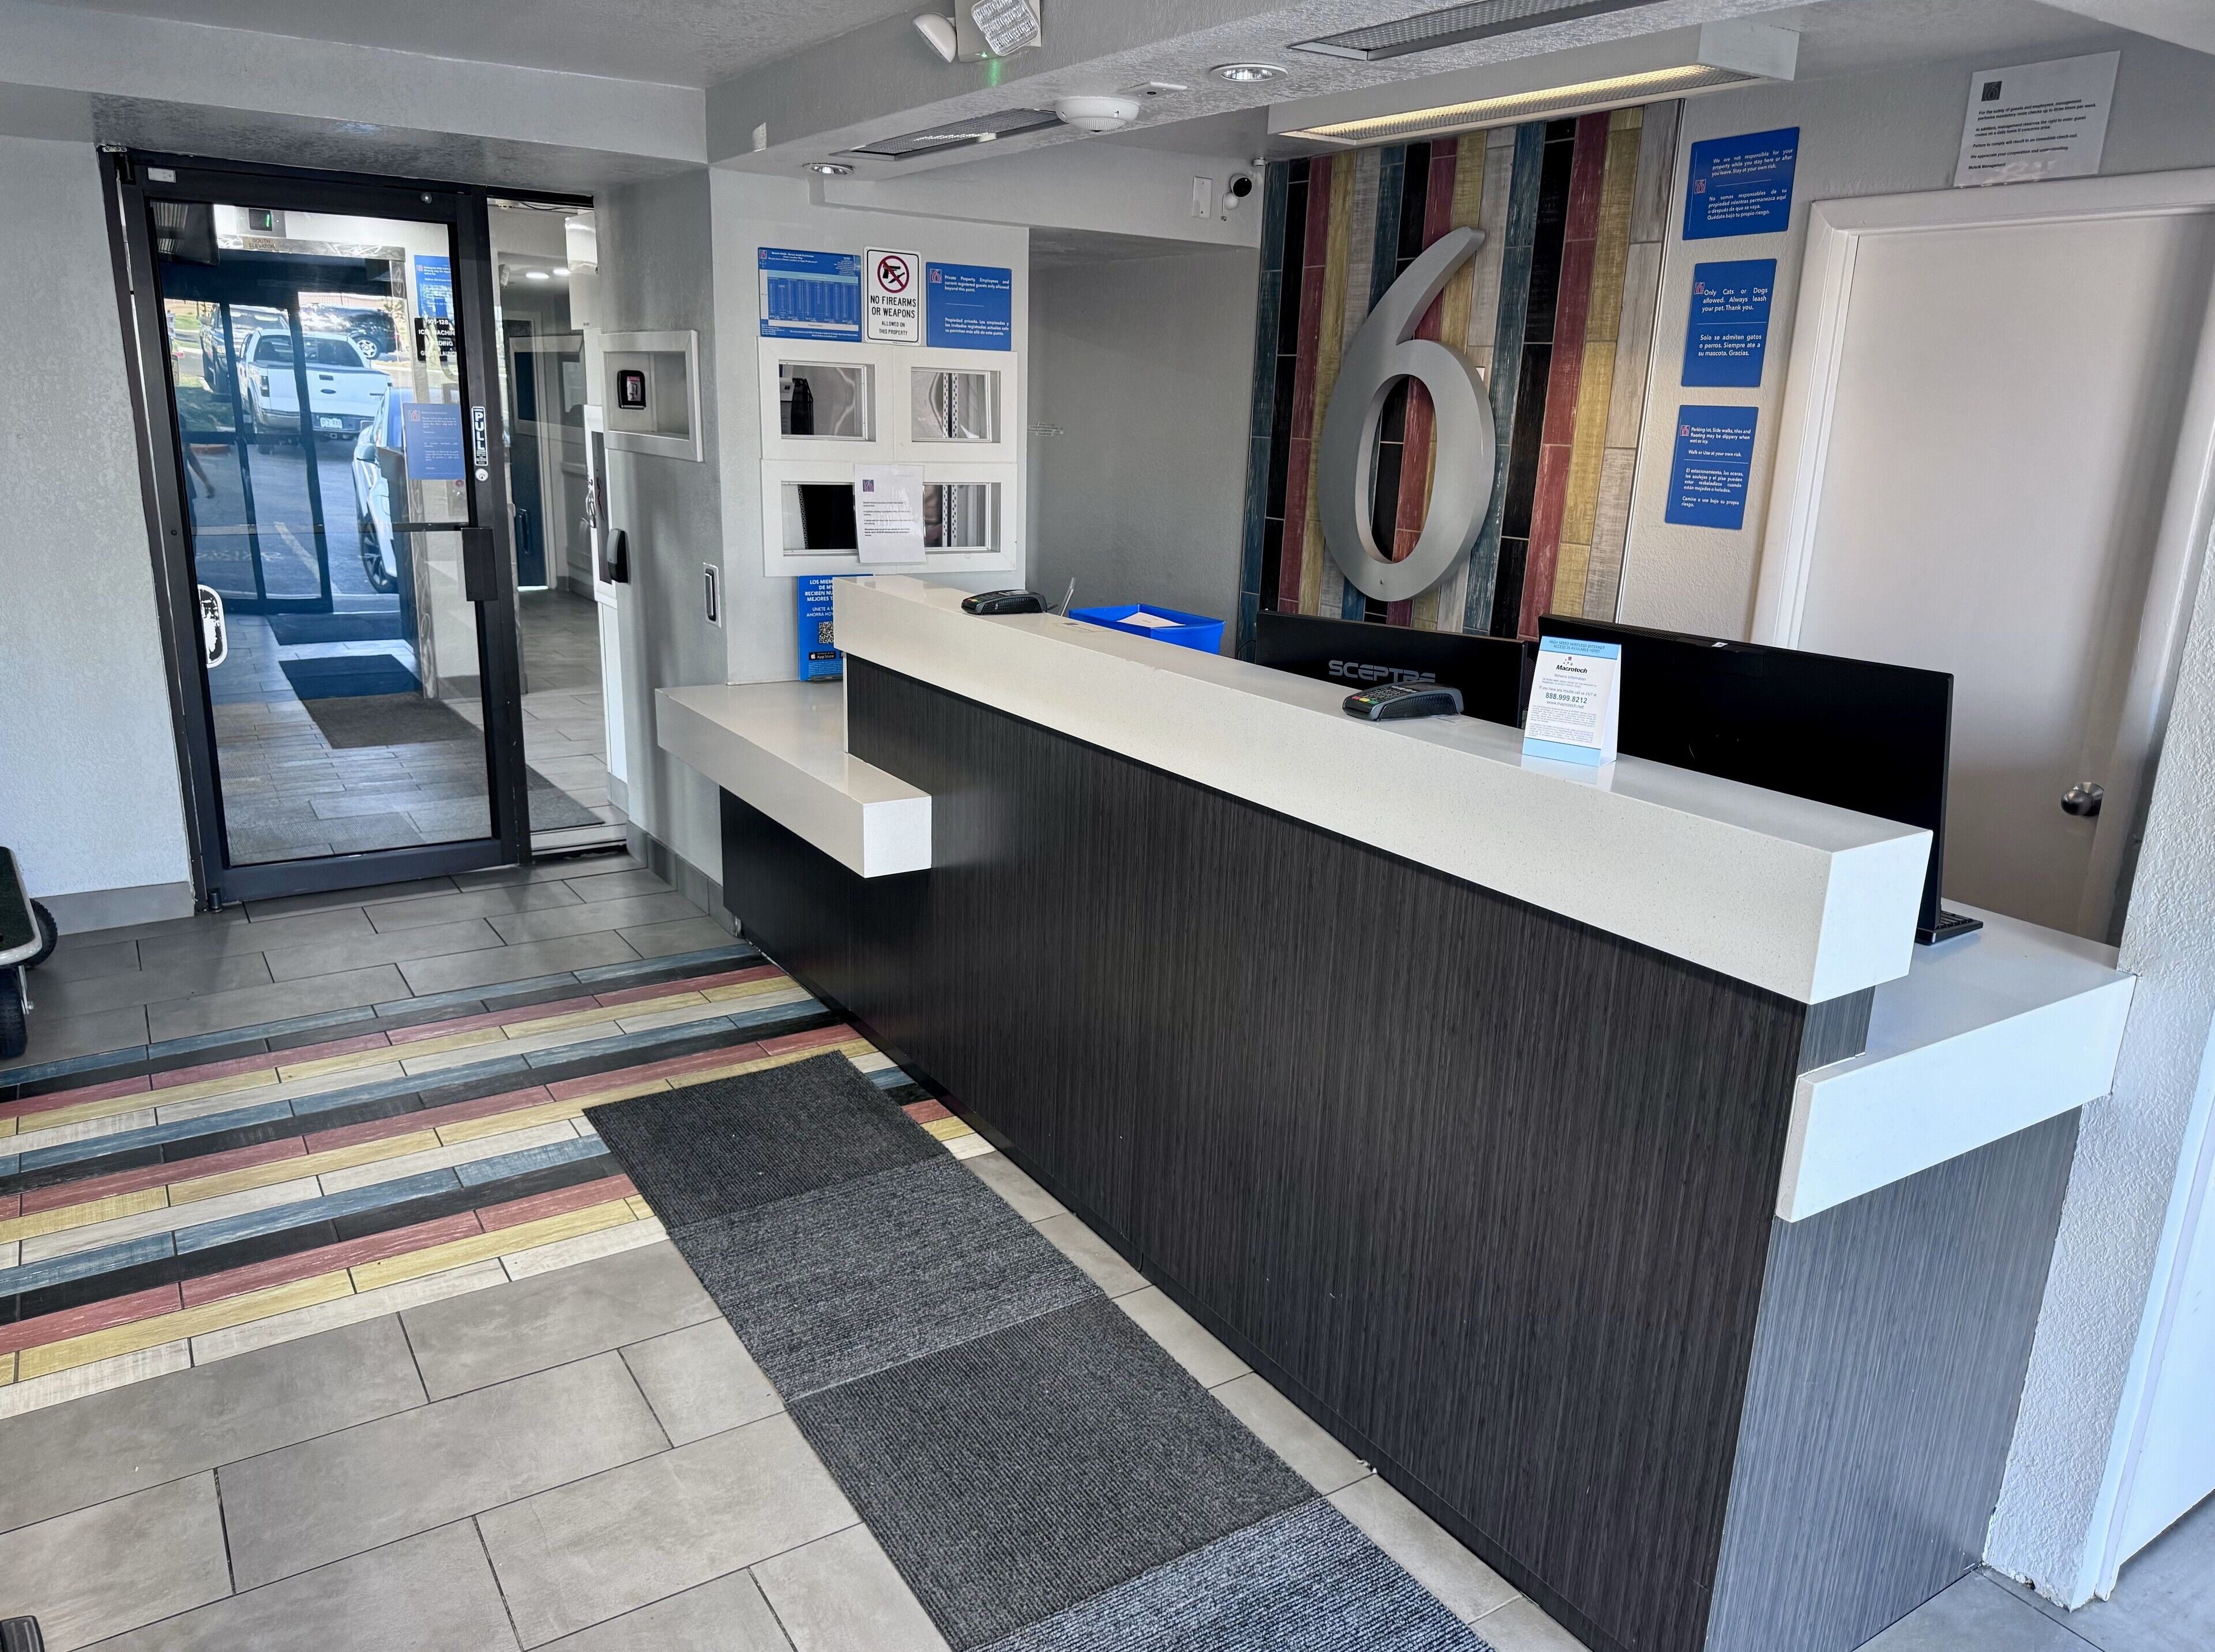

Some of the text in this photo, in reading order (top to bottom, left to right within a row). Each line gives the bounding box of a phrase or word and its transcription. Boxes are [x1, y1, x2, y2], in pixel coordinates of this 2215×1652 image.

[870, 295, 916, 307] NO FIREARMS
[872, 307, 915, 318] OR WEAPONS
[1317, 226, 1495, 602] 6
[475, 412, 485, 450] PULL
[1556, 664, 1587, 673] Macrotech
[1546, 692, 1587, 704] 888.999.8212
[1547, 701, 1584, 709] www.macrotech.net
